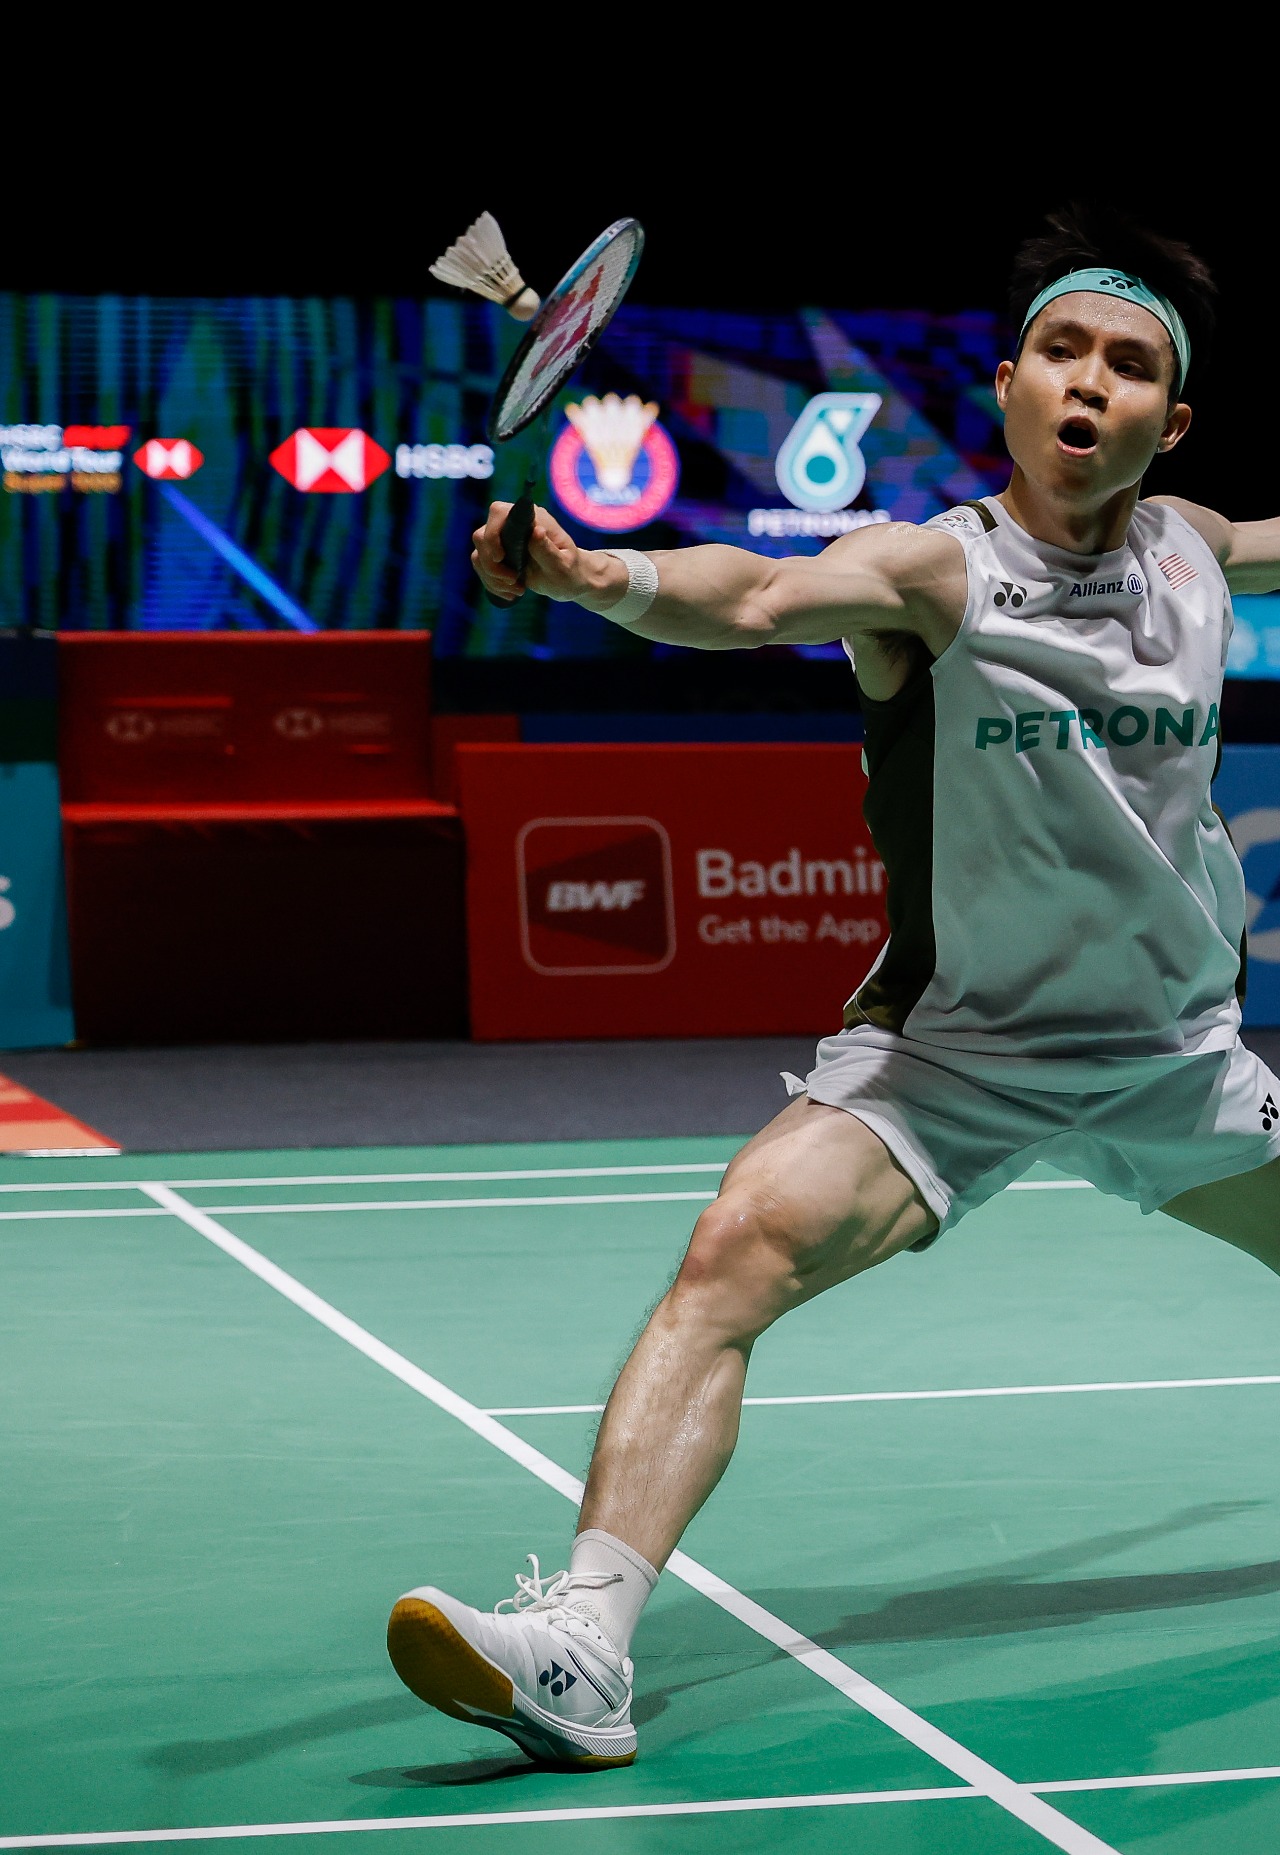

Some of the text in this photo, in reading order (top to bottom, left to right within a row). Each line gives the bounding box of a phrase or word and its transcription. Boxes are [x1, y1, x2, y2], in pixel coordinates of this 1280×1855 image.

[396, 444, 495, 479] HSBC
[1069, 580, 1125, 597] Allianz
[975, 703, 1218, 753] PETRONA
[547, 881, 646, 912] BWF
[699, 912, 882, 944] Get the App
